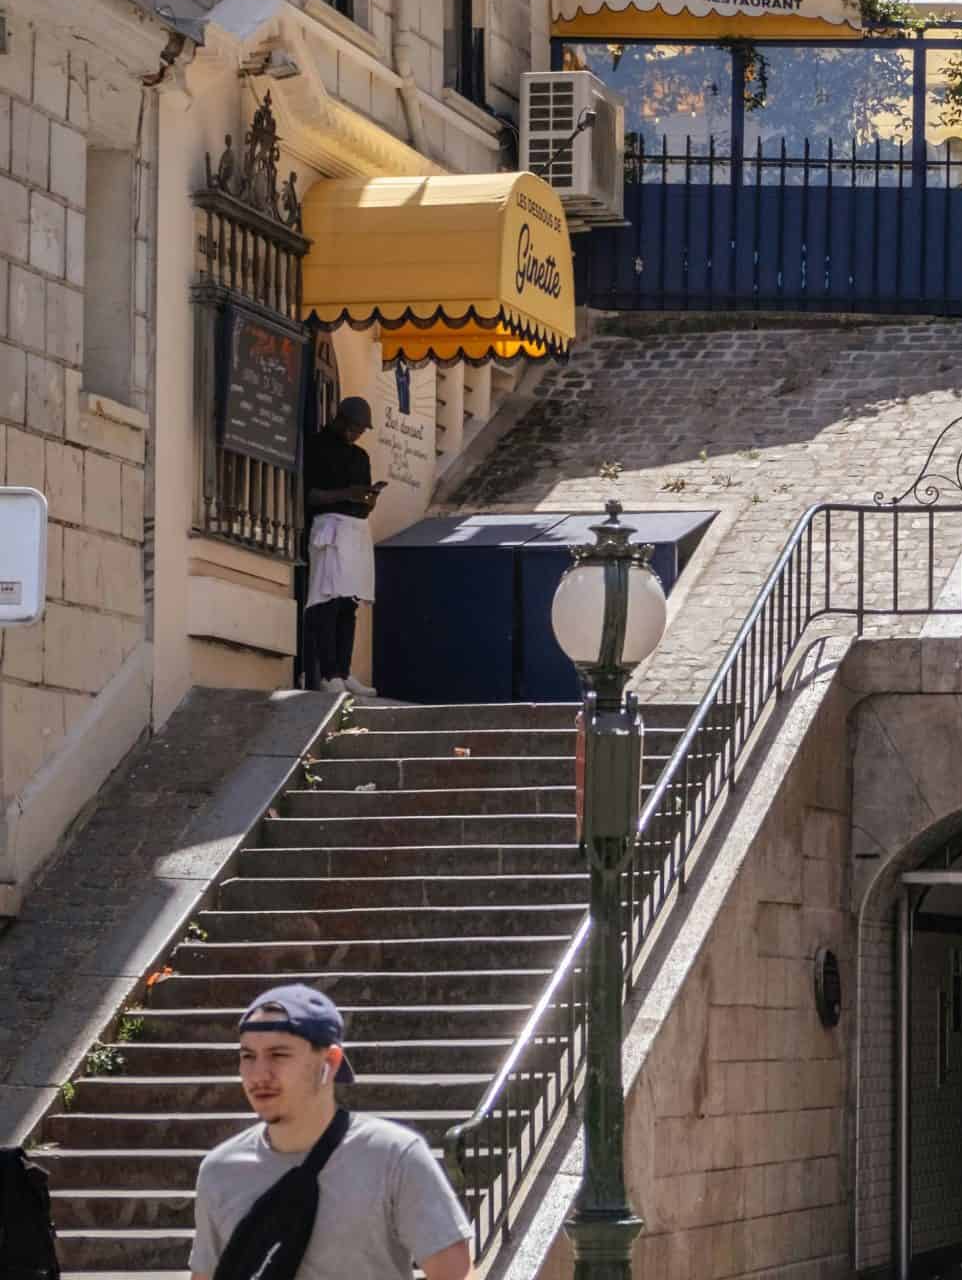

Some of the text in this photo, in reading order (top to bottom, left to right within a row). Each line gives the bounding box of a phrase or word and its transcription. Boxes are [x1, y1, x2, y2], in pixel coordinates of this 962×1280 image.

[517, 192, 562, 233] LES DESSOUS DE
[515, 223, 562, 299] Ginette
